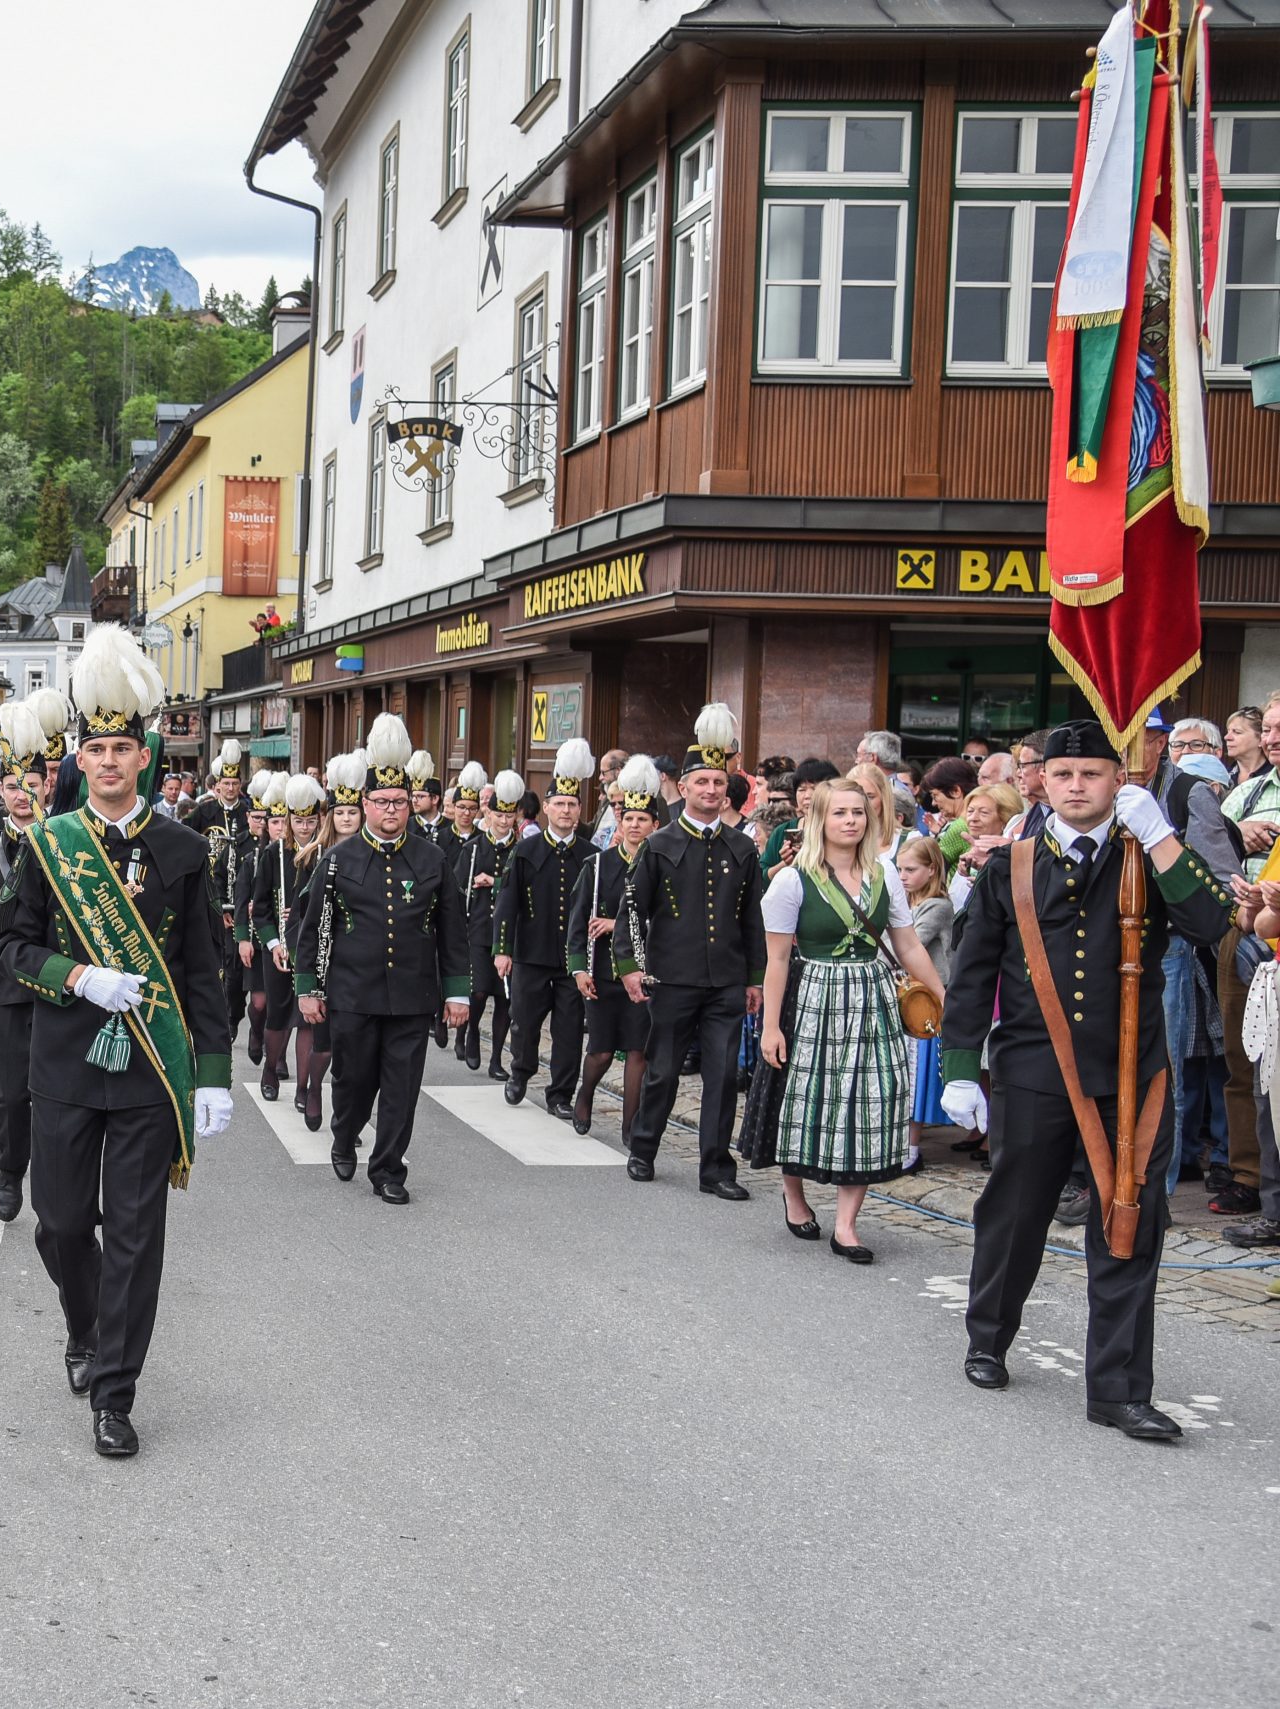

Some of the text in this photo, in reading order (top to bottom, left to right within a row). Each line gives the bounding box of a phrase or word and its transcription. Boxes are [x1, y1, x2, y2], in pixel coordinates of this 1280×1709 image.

[397, 422, 454, 440] Bank
[228, 511, 276, 524] Winkler
[524, 552, 644, 618] RAIFFEISENBANK
[436, 612, 489, 653] Immobilien
[92, 880, 127, 935] Salinen
